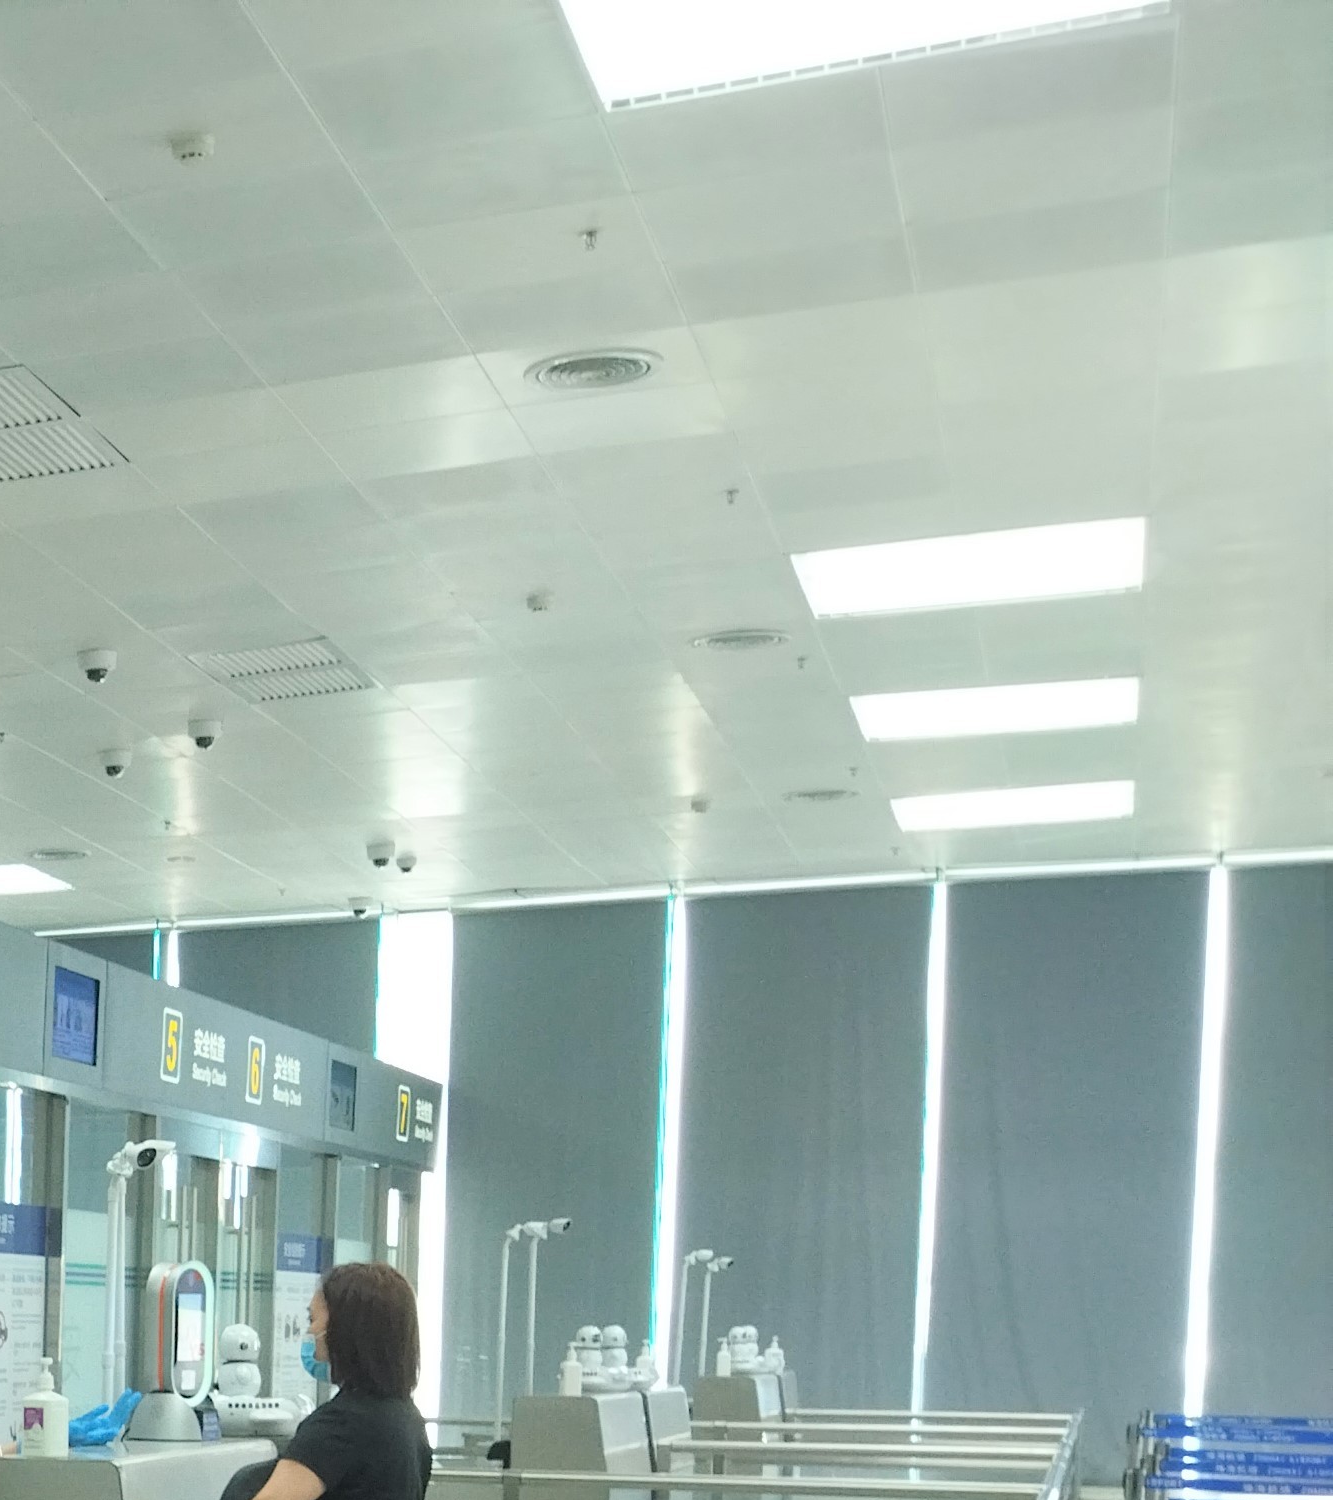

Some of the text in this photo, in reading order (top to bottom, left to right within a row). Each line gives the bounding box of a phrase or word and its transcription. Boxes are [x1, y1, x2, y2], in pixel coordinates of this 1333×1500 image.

[165, 1019, 178, 1072] 5
[251, 1047, 260, 1095] 6
[401, 1093, 408, 1133] 7
